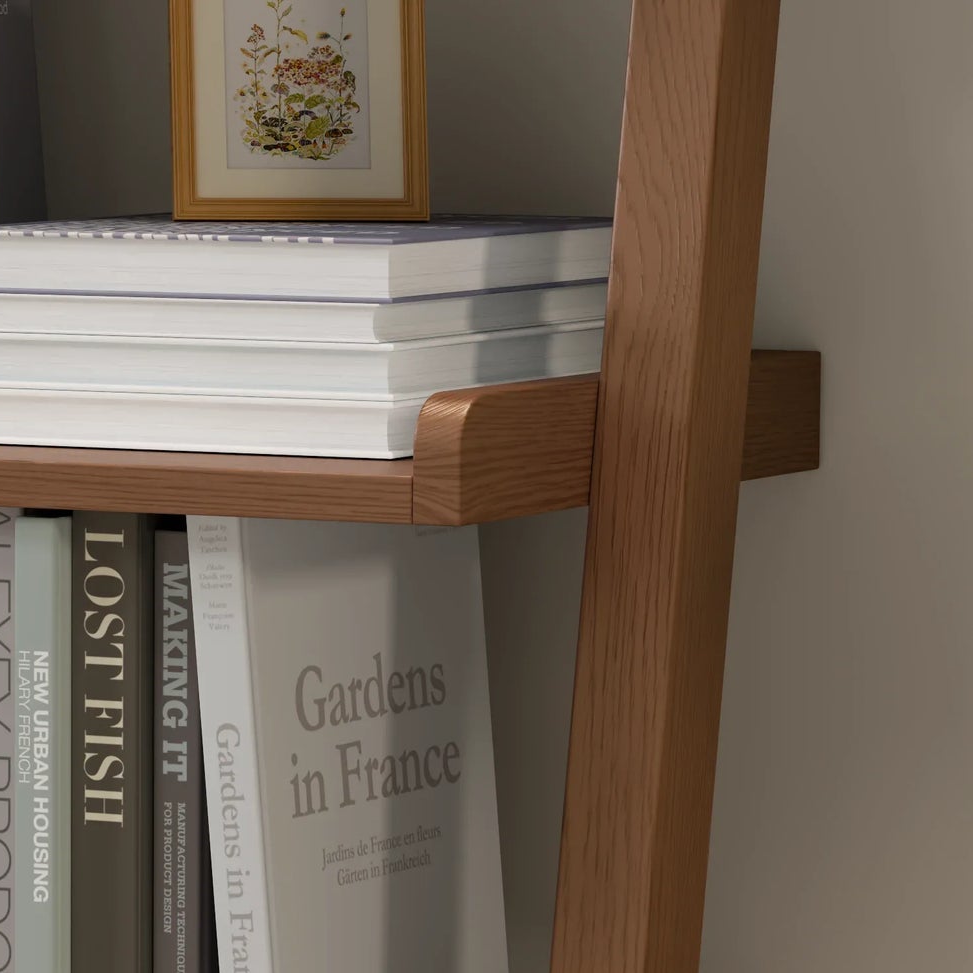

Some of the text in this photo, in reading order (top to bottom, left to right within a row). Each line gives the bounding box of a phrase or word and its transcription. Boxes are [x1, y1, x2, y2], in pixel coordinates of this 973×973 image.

[19, 650, 30, 784] HILARY FRENCH
[83, 528, 125, 828] LOST FISH
[163, 562, 188, 782] MAKING IT
[295, 651, 447, 732] Gardens
[33, 651, 49, 903] NEW URBAN HOUSING
[215, 722, 245, 859] Gardens
[289, 738, 461, 819] in France
[163, 802, 172, 934] FOR PRODUCT DESIGN
[177, 802, 186, 909] MANUFACTURING
[227, 868, 250, 900] in
[322, 825, 442, 871] Jardins de France en fleurs
[337, 848, 431, 887] Gärten in Frankreich
